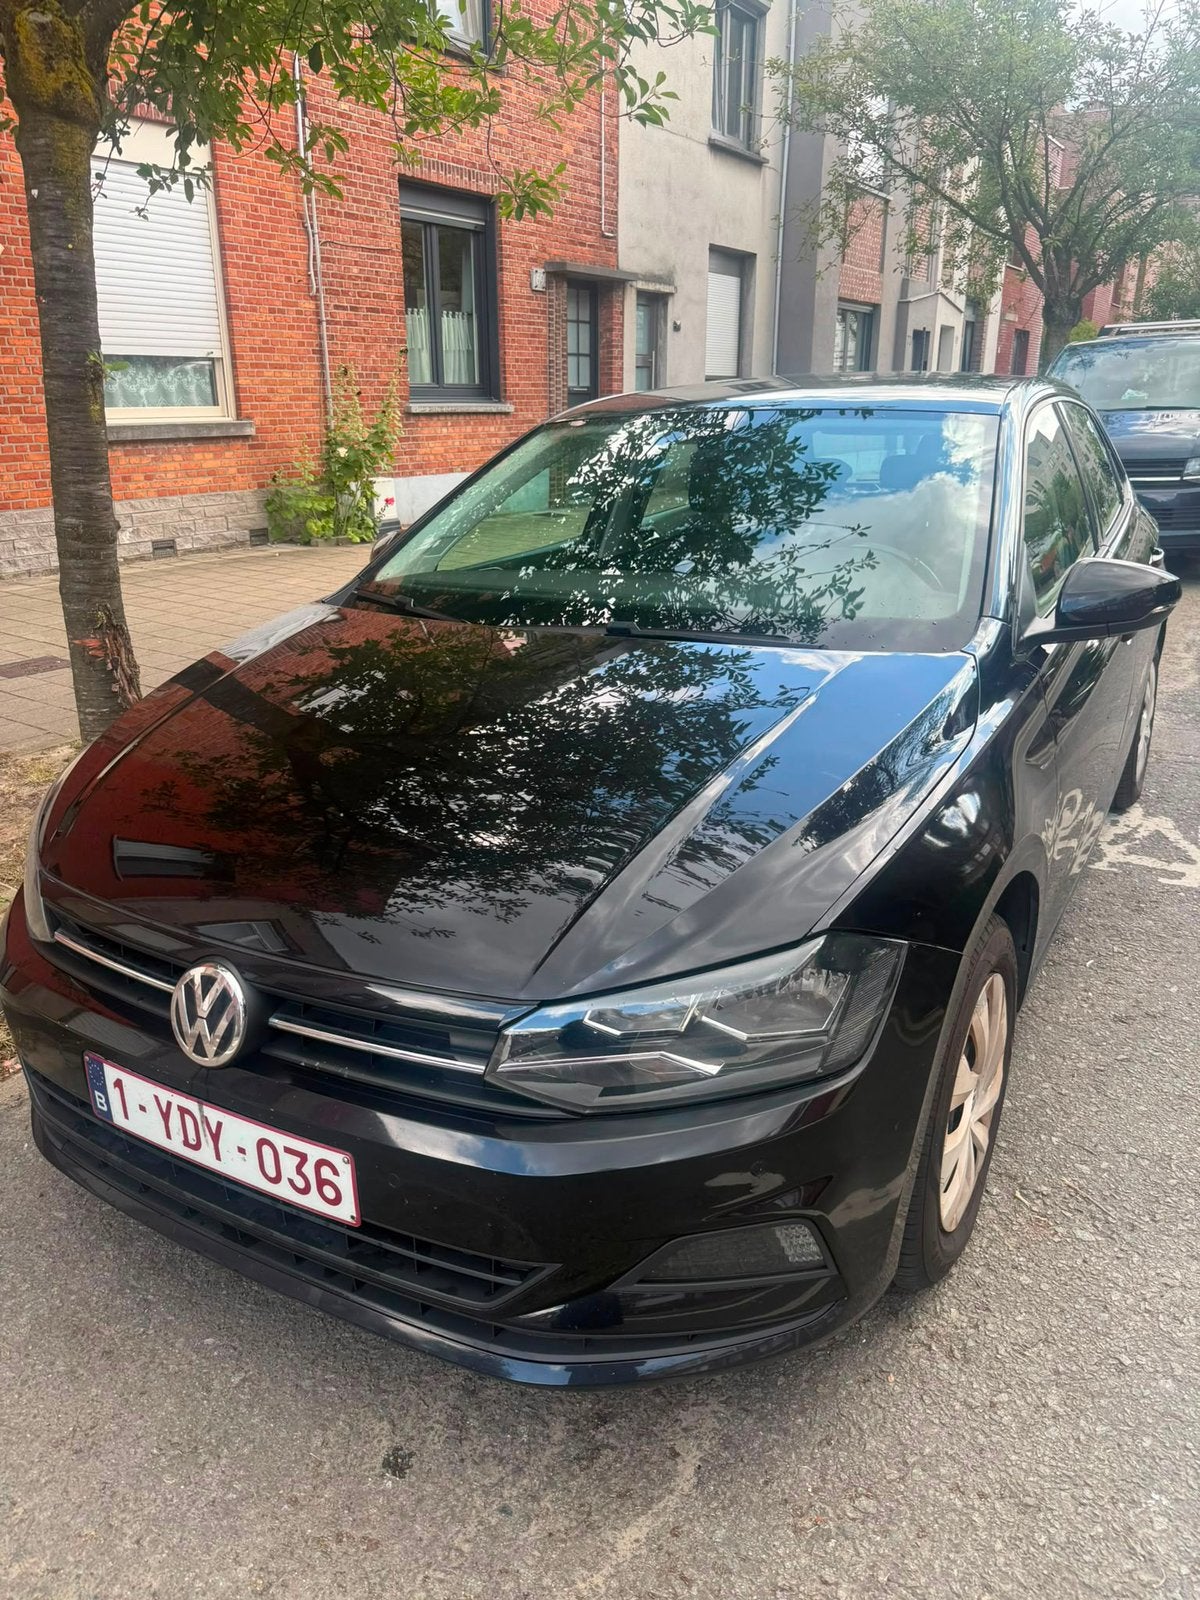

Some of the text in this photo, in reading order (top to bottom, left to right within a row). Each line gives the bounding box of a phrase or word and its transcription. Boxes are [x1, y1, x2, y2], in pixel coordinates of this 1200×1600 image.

[173, 966, 244, 1065] VW
[94, 1090, 107, 1112] B
[113, 1078, 343, 1206] 1-YDY-036
